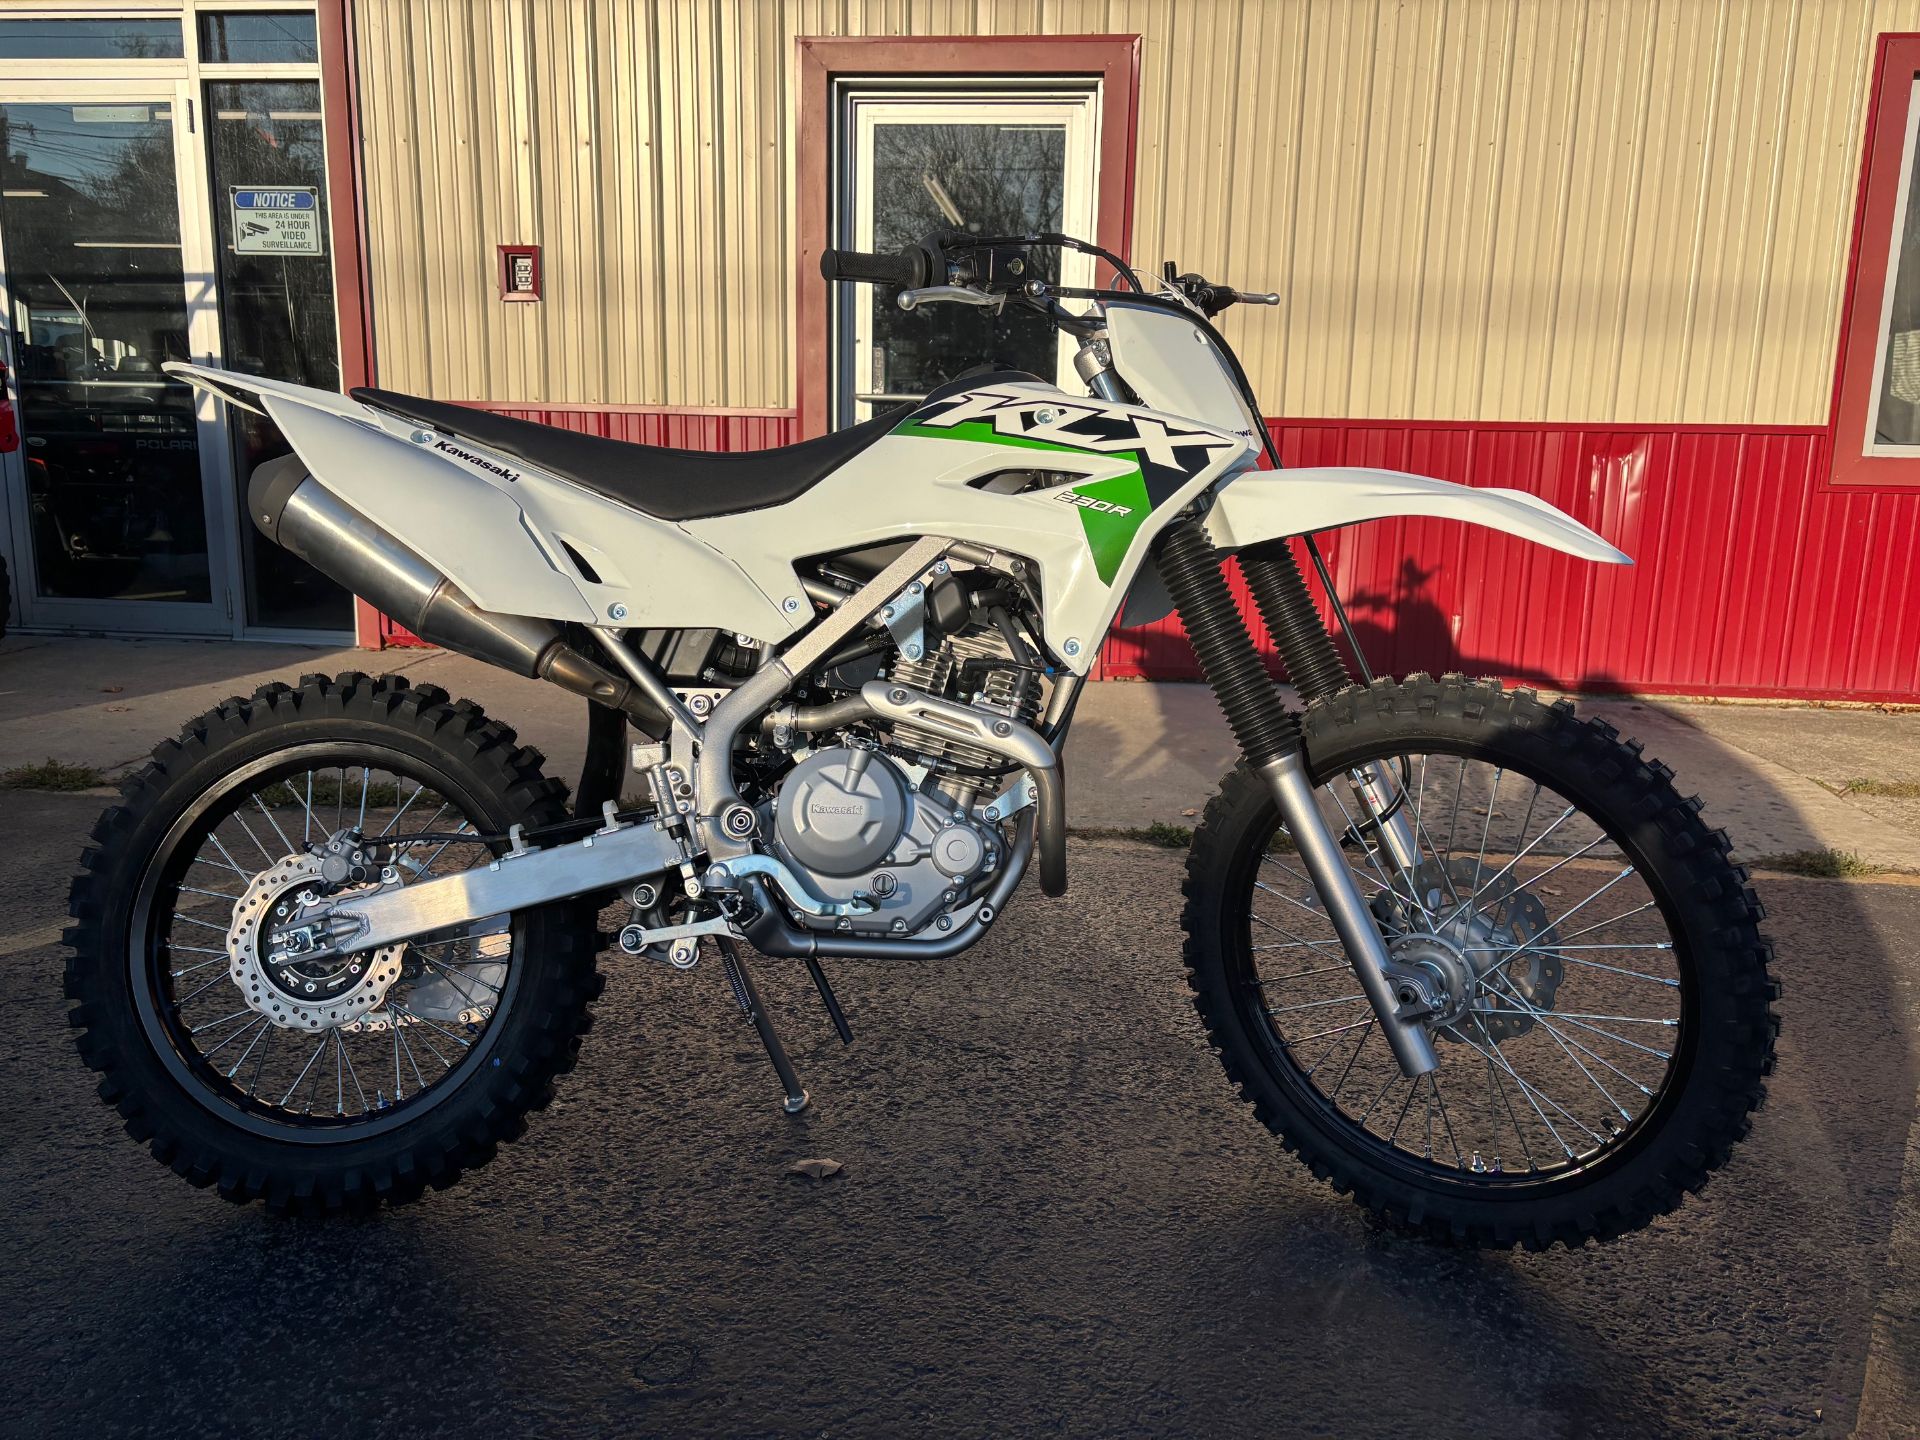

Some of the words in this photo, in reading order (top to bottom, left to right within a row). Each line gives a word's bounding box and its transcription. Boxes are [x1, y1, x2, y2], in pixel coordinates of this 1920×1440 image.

[253, 193, 296, 207] NOTICE
[275, 220, 285, 229] 24
[288, 221, 310, 230] HOUR
[281, 231, 306, 240] VIDEO
[262, 240, 312, 249] SURVEILLANCE
[912, 392, 1236, 474] KLX
[434, 440, 521, 483] Kawasaki
[1053, 490, 1135, 518] 230R
[811, 803, 864, 815] Kawasaki
